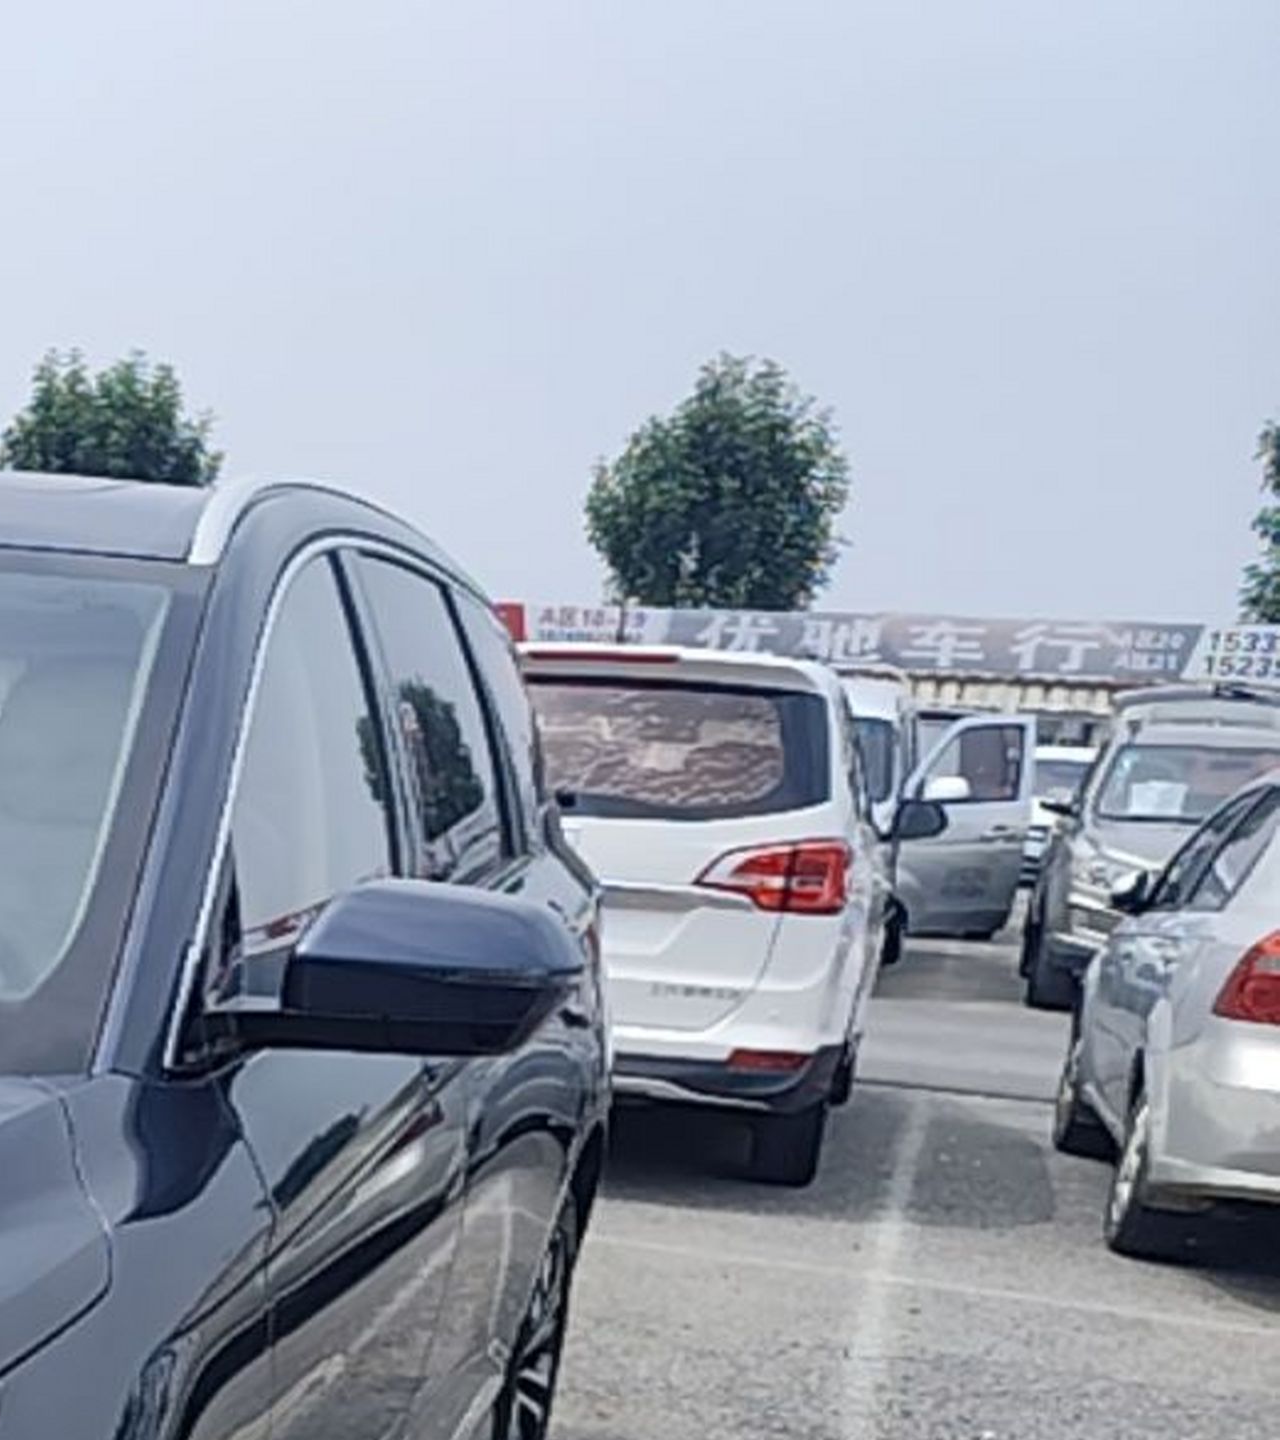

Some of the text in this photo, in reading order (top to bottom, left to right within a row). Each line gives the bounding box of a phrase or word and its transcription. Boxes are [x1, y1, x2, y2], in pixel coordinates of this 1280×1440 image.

[696, 613, 1100, 669] 优驰车行
[1210, 629, 1280, 653] 1533
